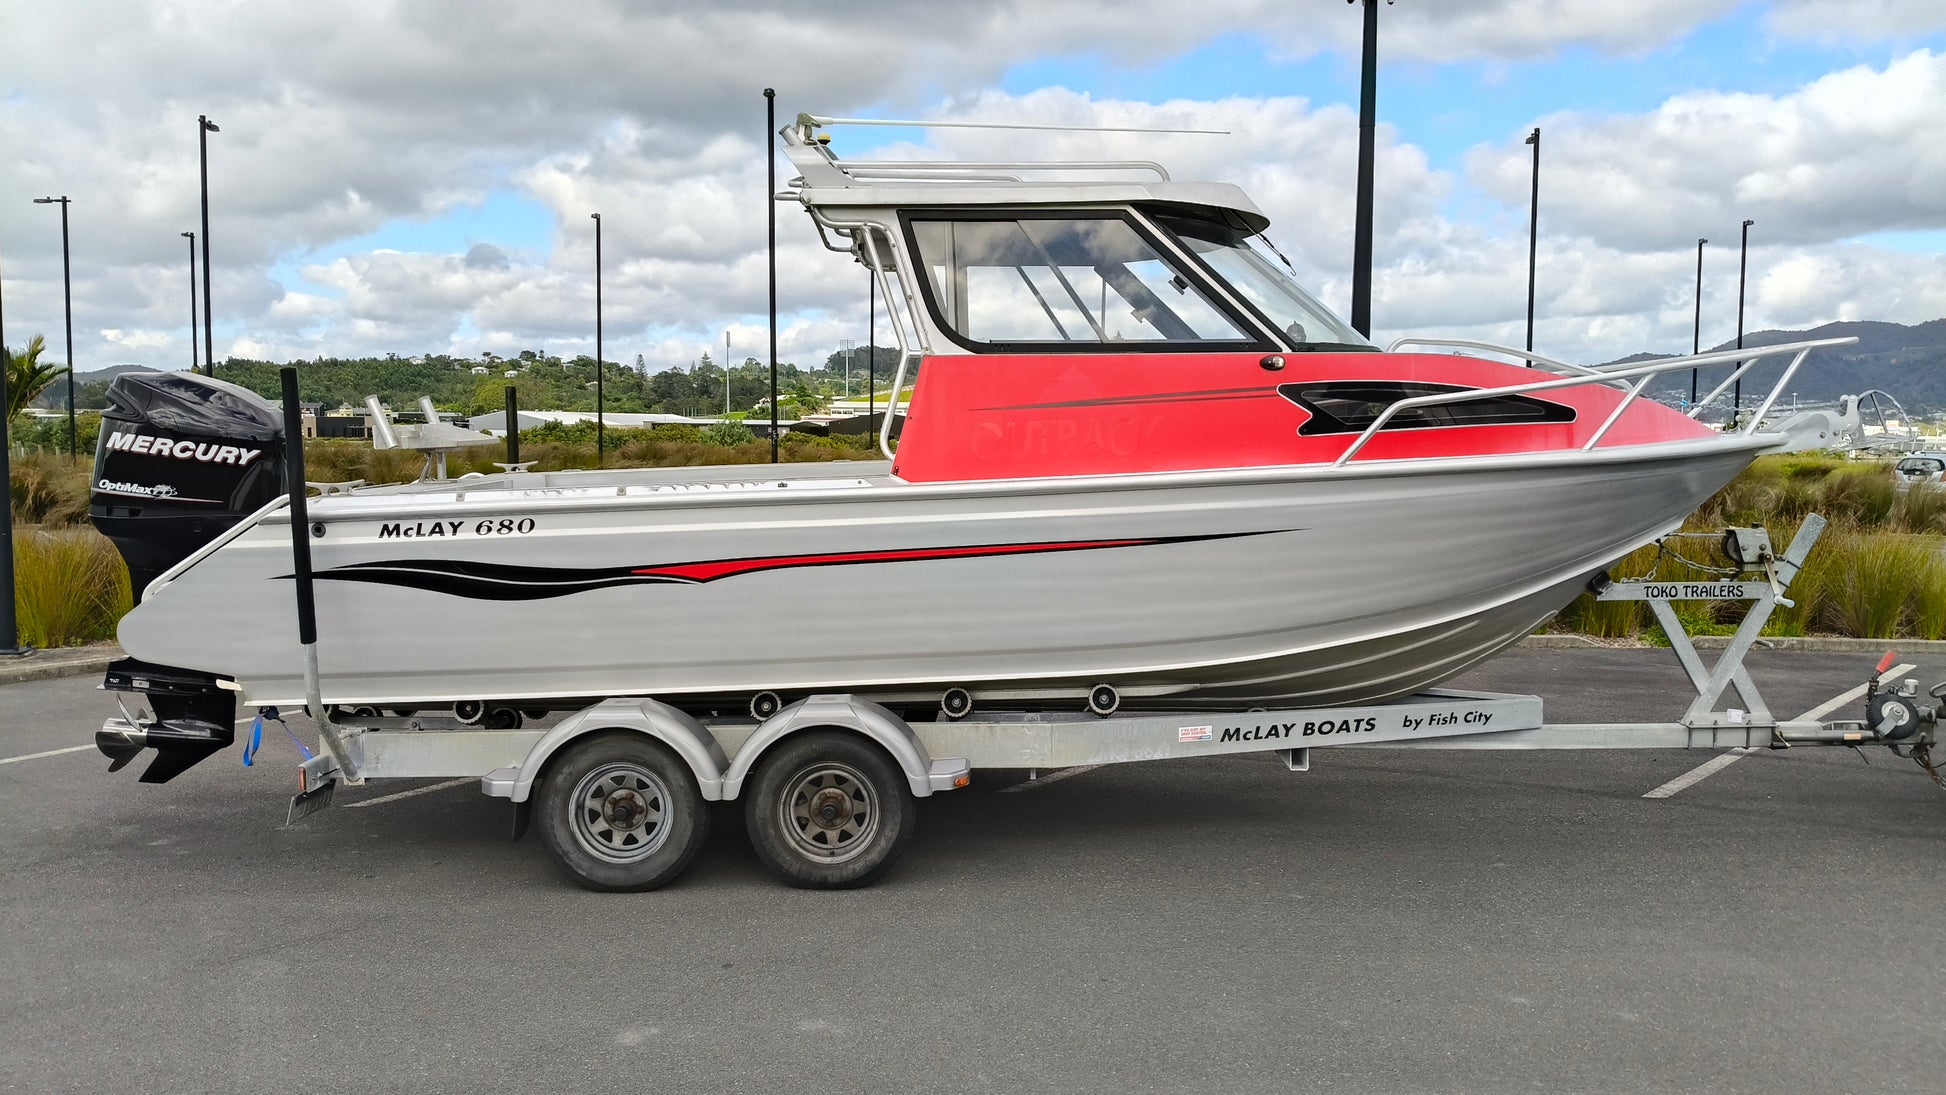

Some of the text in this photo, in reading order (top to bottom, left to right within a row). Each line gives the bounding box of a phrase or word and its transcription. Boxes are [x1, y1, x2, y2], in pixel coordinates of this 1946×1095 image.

[105, 431, 261, 466] MERCURY
[98, 479, 154, 495] OptiMax
[378, 518, 536, 538] McLAY 680
[1643, 585, 1744, 598] TOKO TRAILERS
[1219, 711, 1494, 743] McLAY BOATS by Fish City
